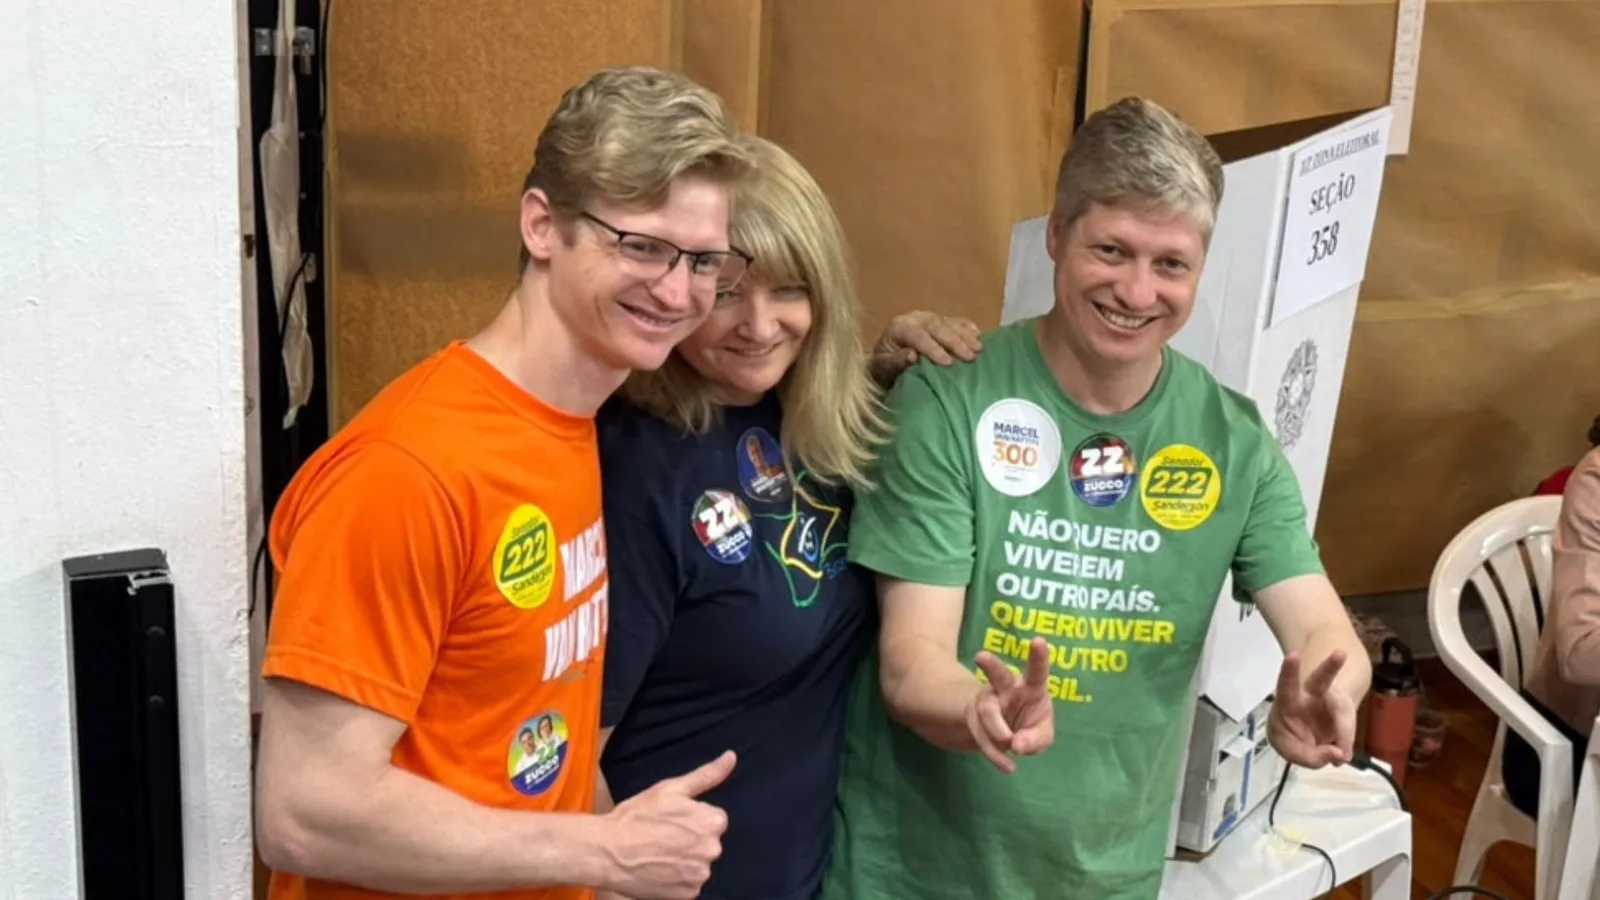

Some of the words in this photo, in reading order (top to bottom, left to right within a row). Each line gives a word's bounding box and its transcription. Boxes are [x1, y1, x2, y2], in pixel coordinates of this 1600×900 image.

[1308, 172, 1355, 215] SEÇÃO
[1307, 221, 1339, 265] 358
[994, 421, 1039, 439] MARCEL
[994, 440, 1038, 467] 300
[1081, 445, 1124, 477] 22
[1084, 479, 1124, 492] ZUCCO
[1149, 470, 1207, 494] 222
[699, 498, 738, 541] 22
[1008, 509, 1072, 543] NÃO
[503, 529, 546, 577] 222
[1081, 553, 1125, 582] EM
[996, 572, 1089, 609] OUTRO
[1090, 584, 1161, 613] PAÍS.
[990, 600, 1088, 640] QUERO
[1089, 617, 1176, 645] VIVER
[983, 627, 1032, 662] EM
